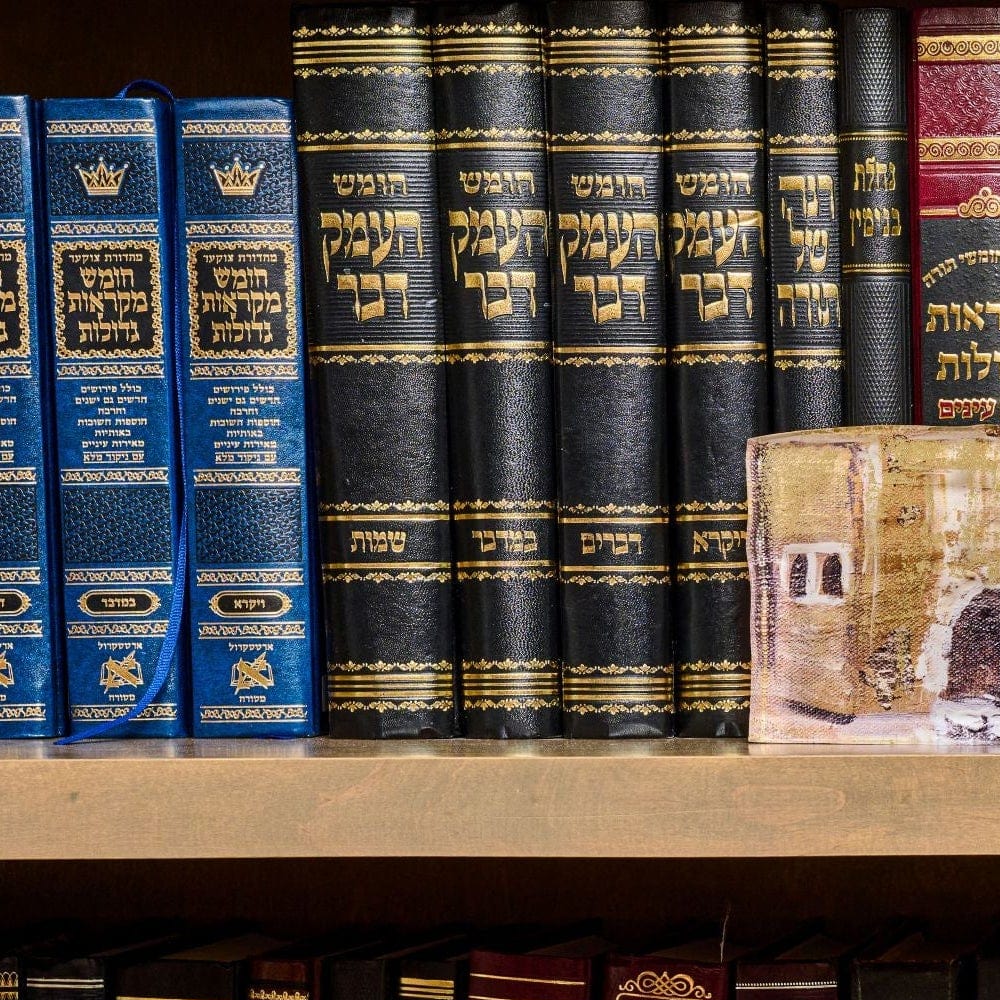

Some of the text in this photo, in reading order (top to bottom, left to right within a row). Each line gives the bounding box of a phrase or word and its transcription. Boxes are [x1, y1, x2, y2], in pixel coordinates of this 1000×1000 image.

[333, 172, 407, 195] חומש
[460, 170, 535, 194] חומש
[571, 172, 646, 198] חומש
[675, 171, 750, 198] חומש
[854, 157, 897, 191] נחלת
[668, 208, 765, 274] העמק
[786, 207, 829, 273] של
[850, 207, 901, 247] בנימין
[105, 254, 142, 262] מהדורת
[321, 209, 423, 283] העמק
[448, 207, 549, 281] העמק
[558, 210, 660, 285] העמק
[80, 267, 134, 288] חומש
[214, 267, 268, 288] חומש
[922, 257, 958, 289] תורה
[68, 290, 147, 320] מקראות
[202, 290, 281, 320] מקראות
[337, 273, 408, 322] דבר
[464, 271, 536, 320] דבר
[573, 274, 646, 325] דבר
[680, 272, 753, 322] דבר
[777, 283, 841, 328] תורה
[79, 313, 139, 343] גדולות
[212, 313, 272, 344] גדולות
[120, 383, 141, 392] כולל
[84, 453, 102, 461] מלא
[106, 453, 128, 462] ניקוד
[350, 530, 407, 554] שמות
[472, 530, 538, 553] במדבר
[580, 531, 643, 556] דברים
[102, 598, 135, 607] במדבר
[234, 598, 265, 608] ויקרא
[109, 694, 135, 702] מסורה
